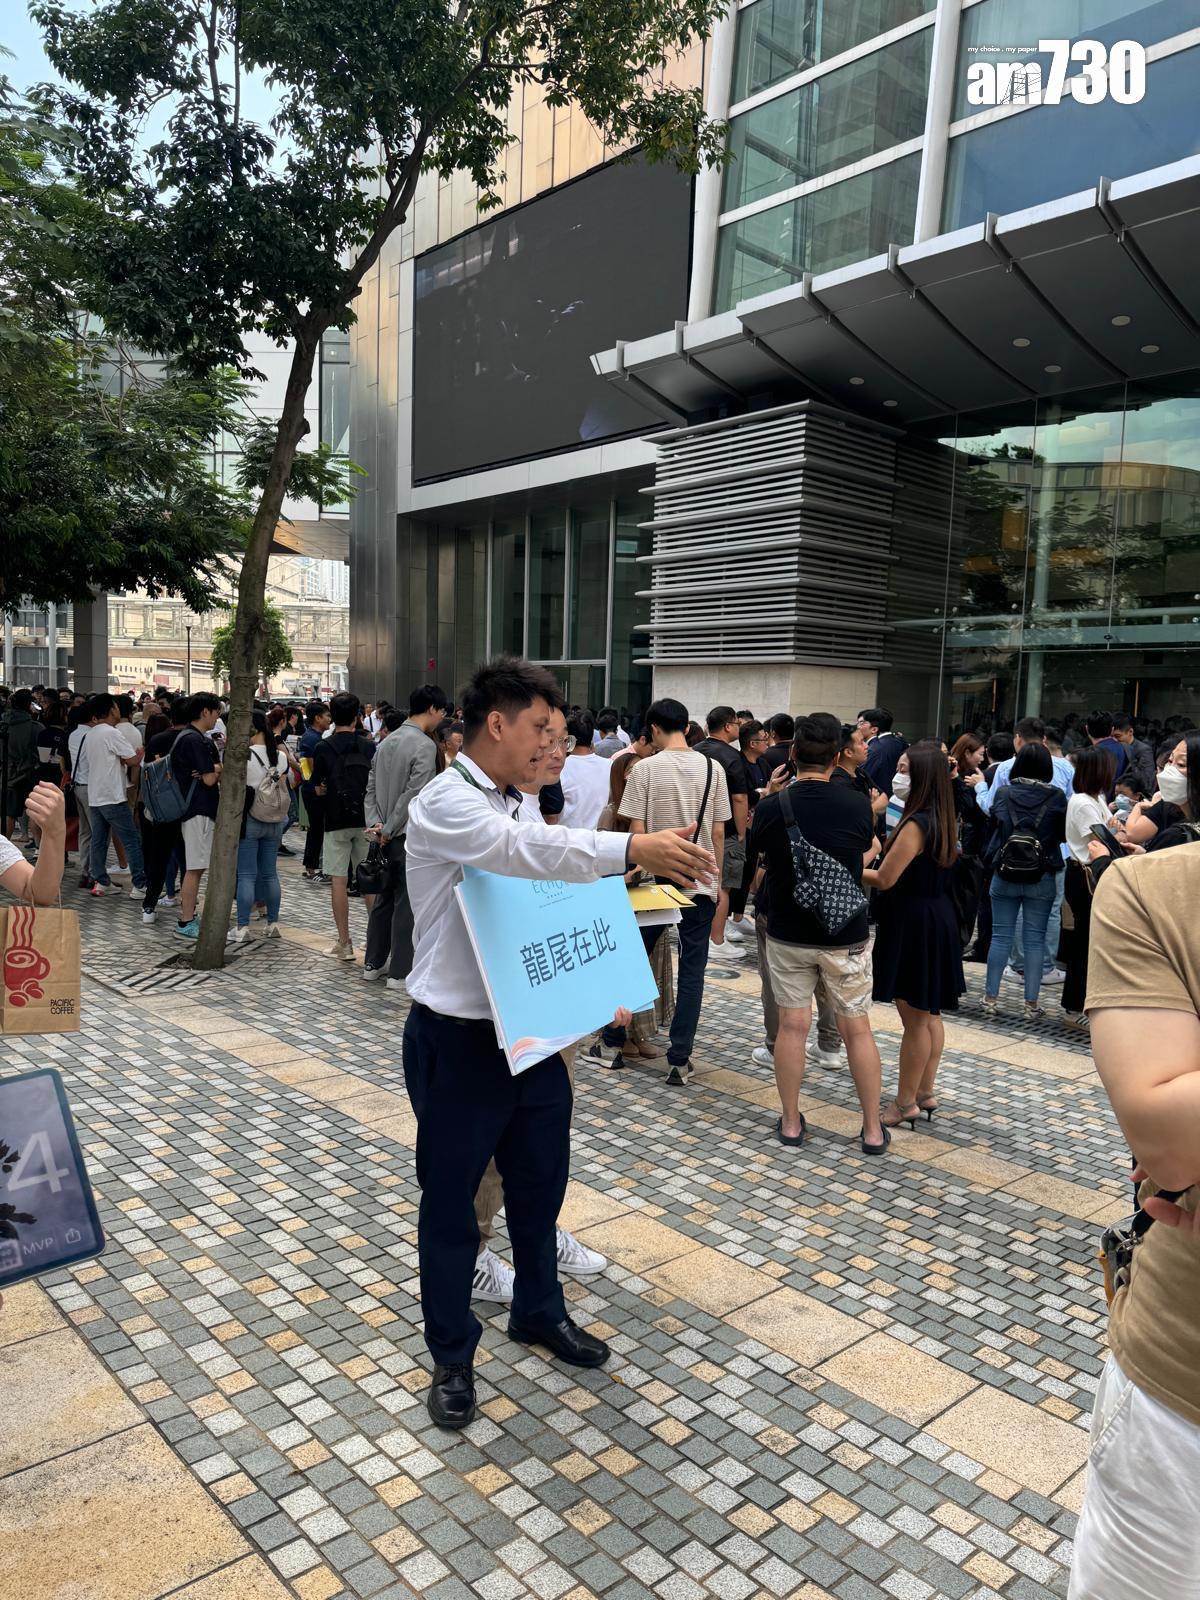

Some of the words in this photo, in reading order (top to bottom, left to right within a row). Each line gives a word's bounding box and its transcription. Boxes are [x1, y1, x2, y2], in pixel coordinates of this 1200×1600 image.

[520, 917, 617, 988] 龍尾在此
[50, 999, 74, 1007] PACIFIC
[50, 1007, 74, 1015] COFFEE
[7, 1130, 70, 1193] 4
[23, 1237, 54, 1256] MVP
